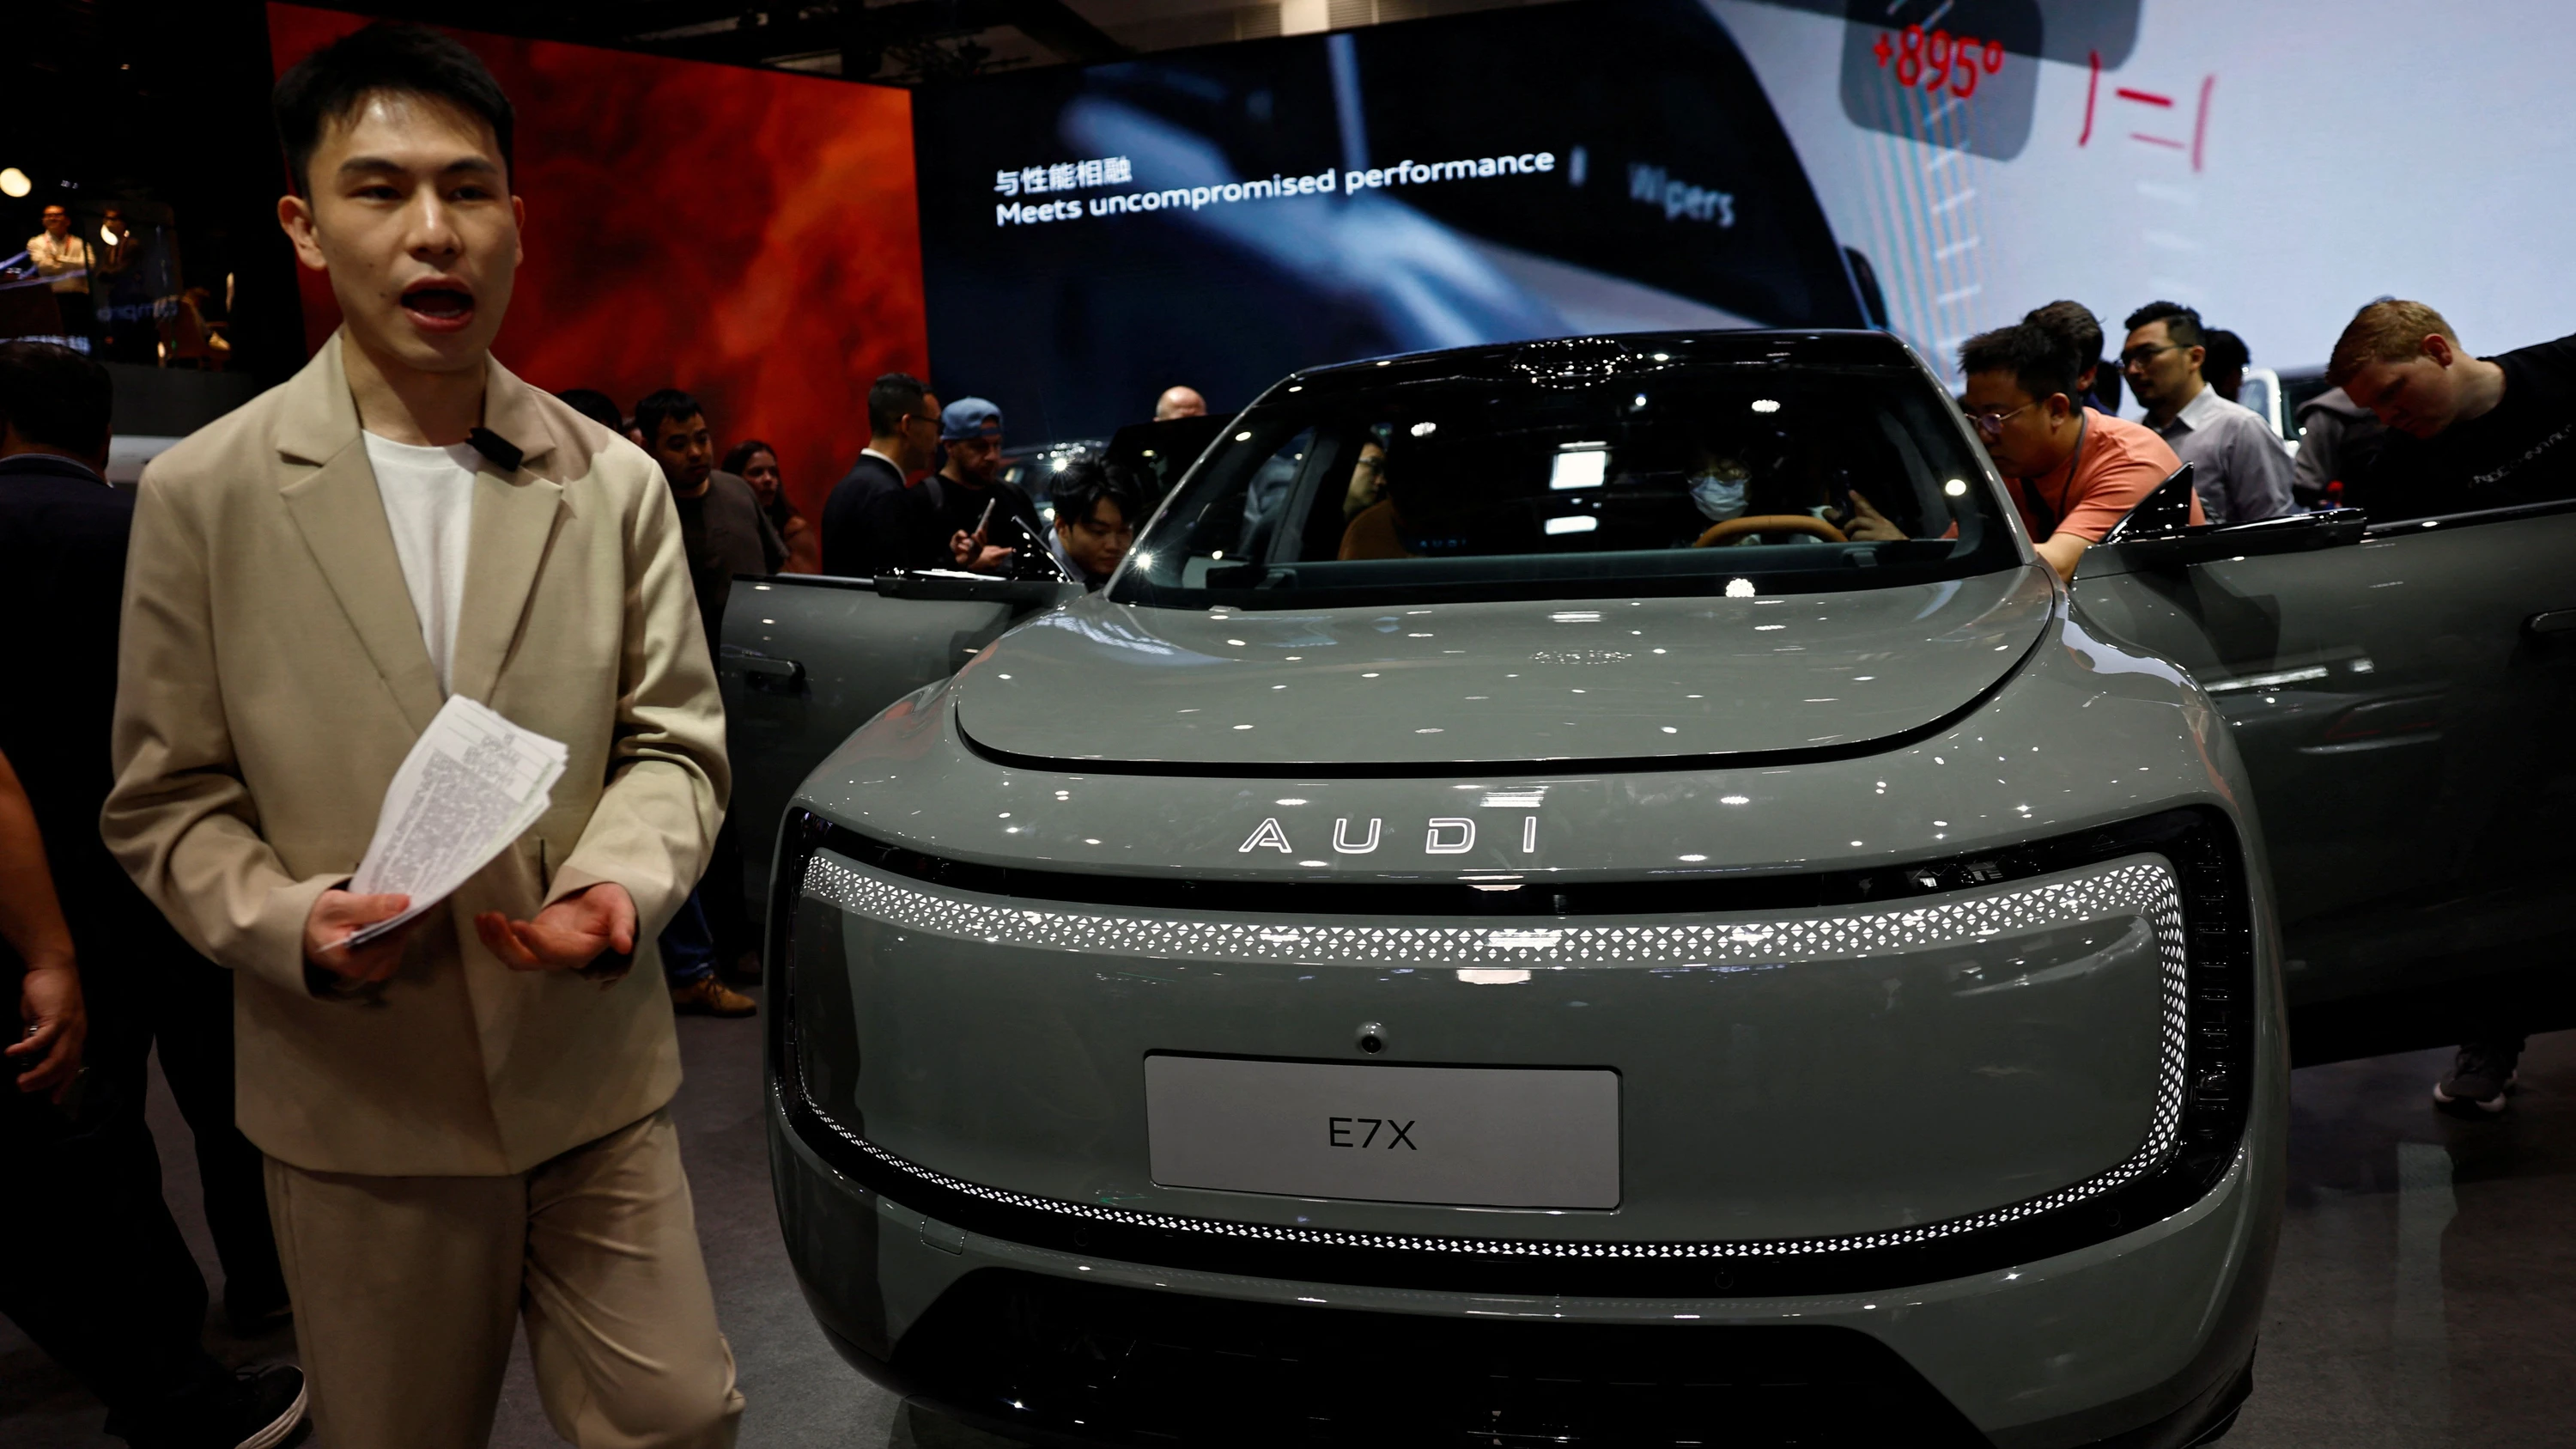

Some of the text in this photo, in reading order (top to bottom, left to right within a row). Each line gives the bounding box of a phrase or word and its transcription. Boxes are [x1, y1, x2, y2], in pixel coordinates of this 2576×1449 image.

[993, 155, 1133, 197] 与性能相融
[996, 151, 1555, 227] Meets uncompromised performance
[1238, 816, 1537, 854] AUDI
[1329, 1117, 1418, 1150] E7X
